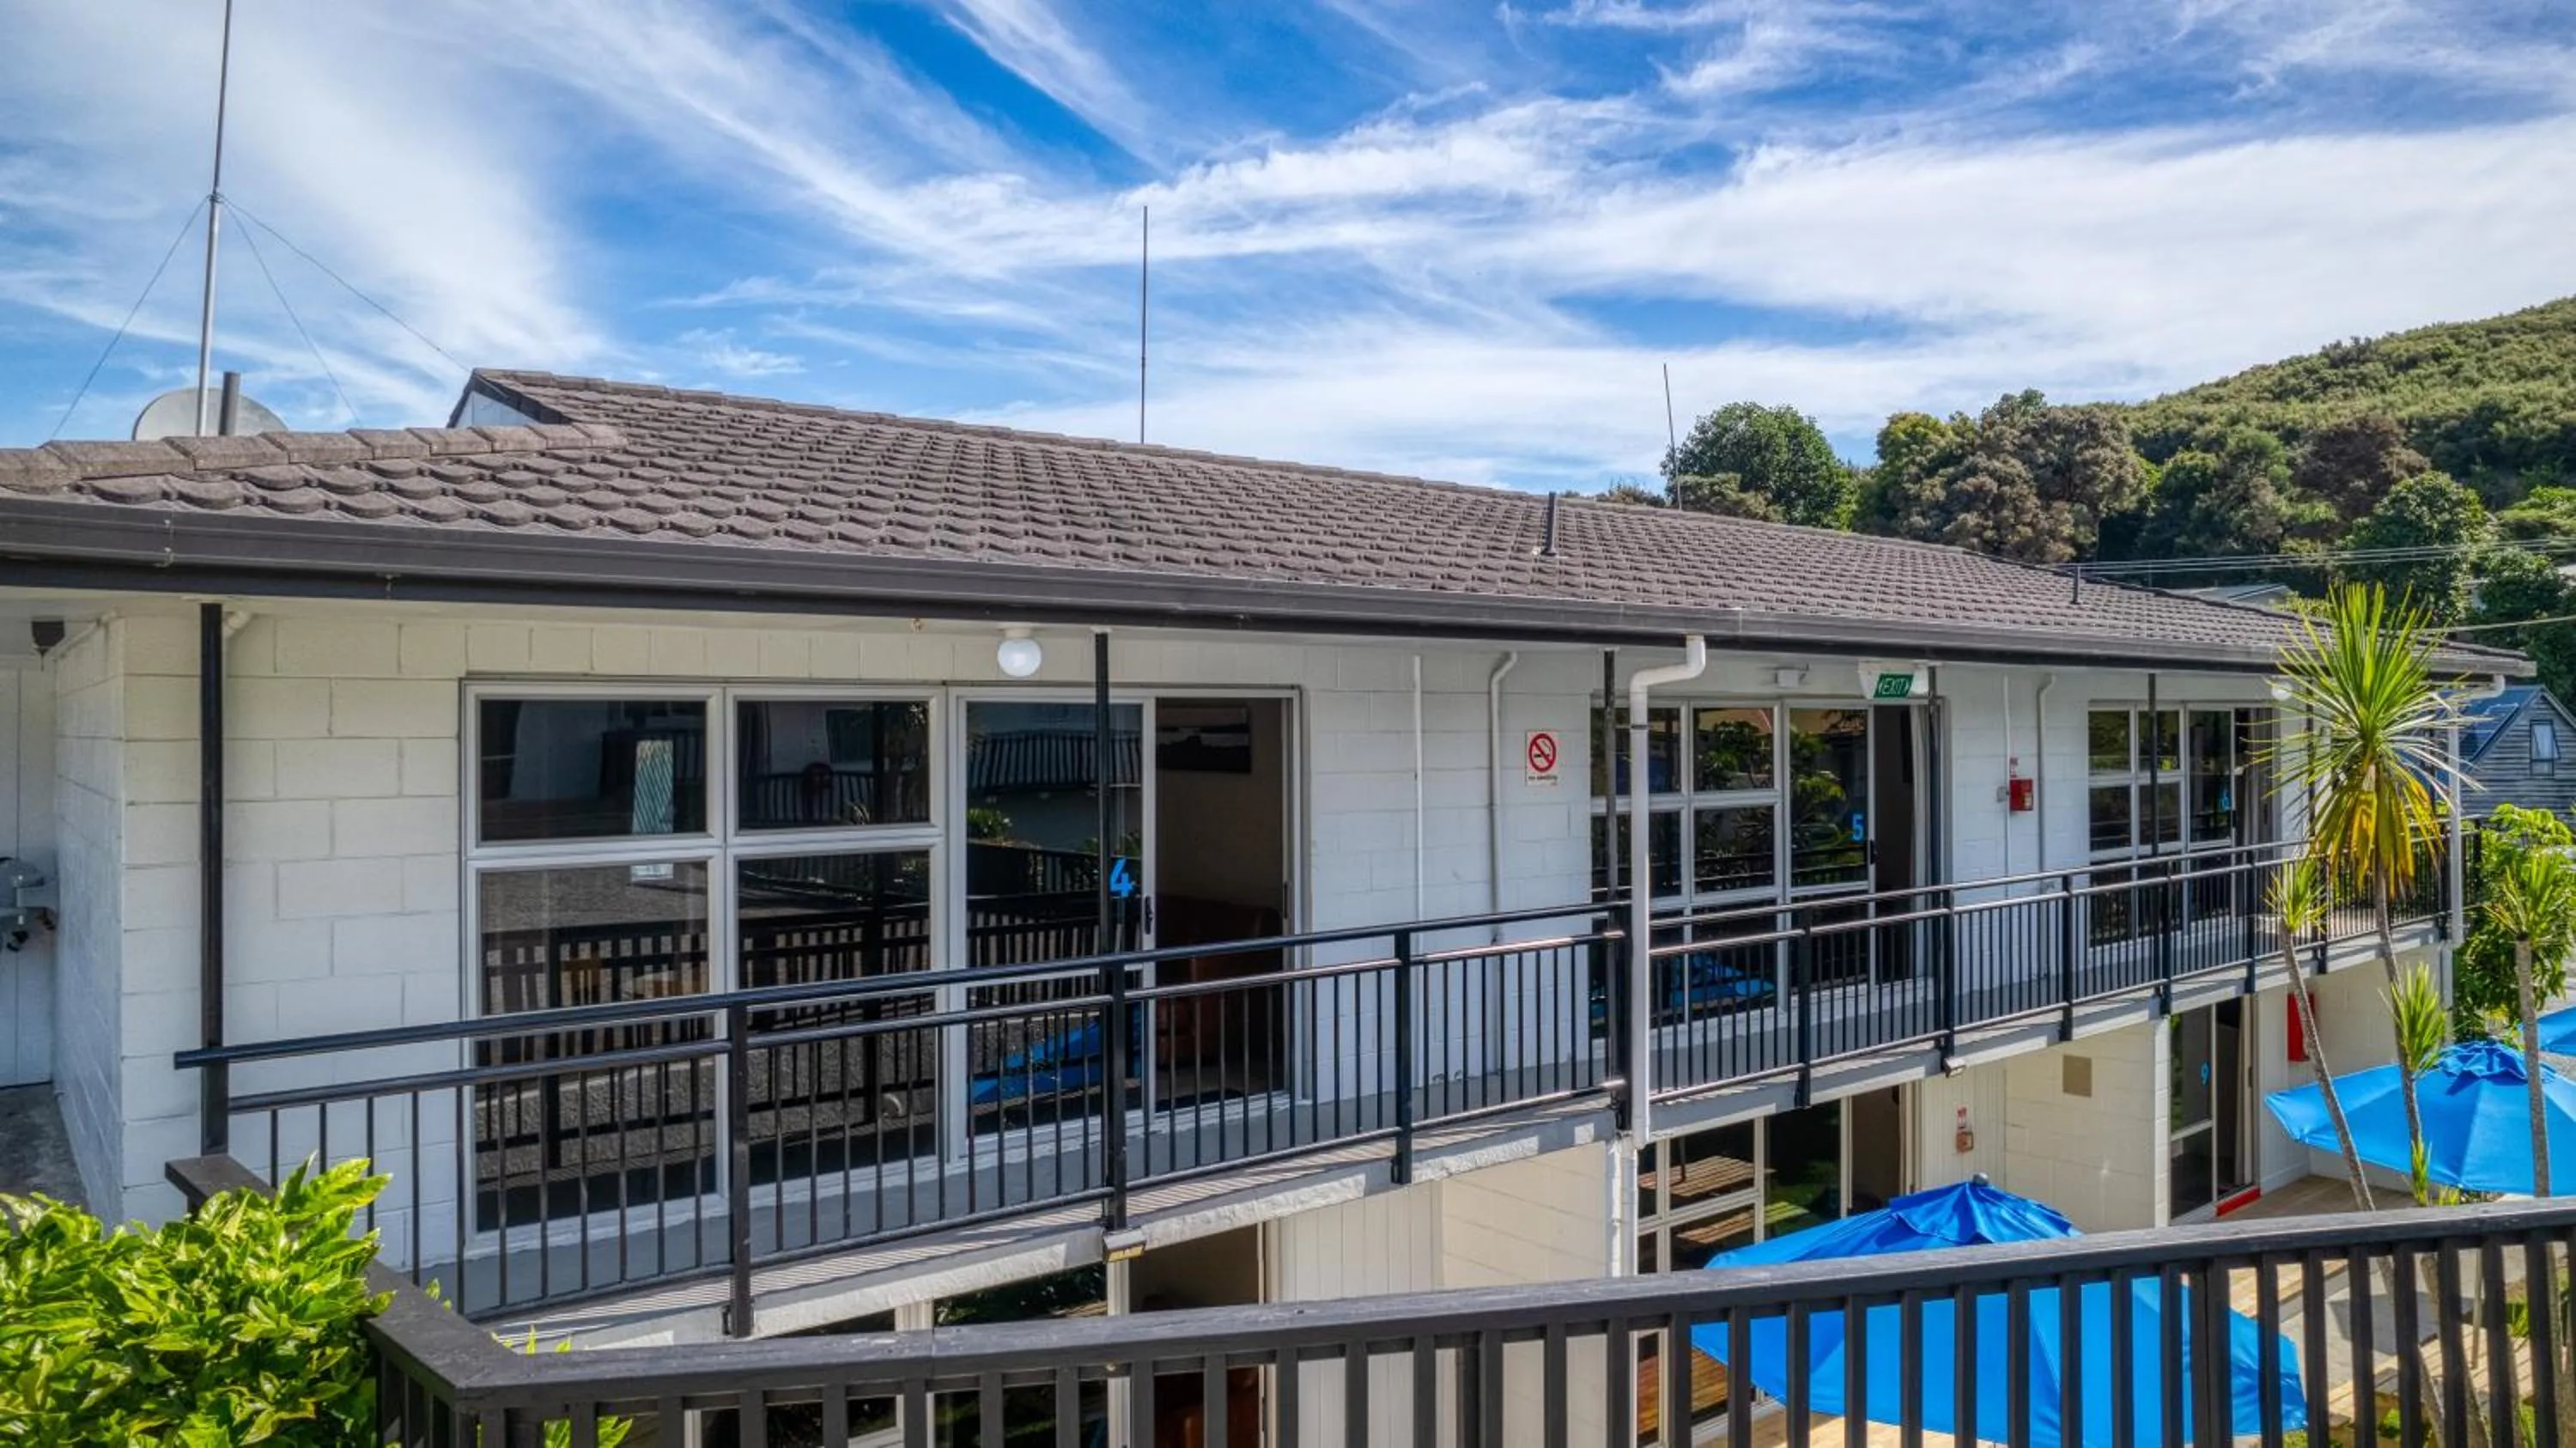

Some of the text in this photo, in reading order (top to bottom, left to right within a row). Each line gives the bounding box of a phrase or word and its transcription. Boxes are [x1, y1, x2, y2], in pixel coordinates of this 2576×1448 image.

[1881, 677, 1906, 695] EXIT
[1852, 813, 1864, 841] 5
[1110, 856, 1133, 897] 4
[2201, 1062, 2209, 1086] 9
